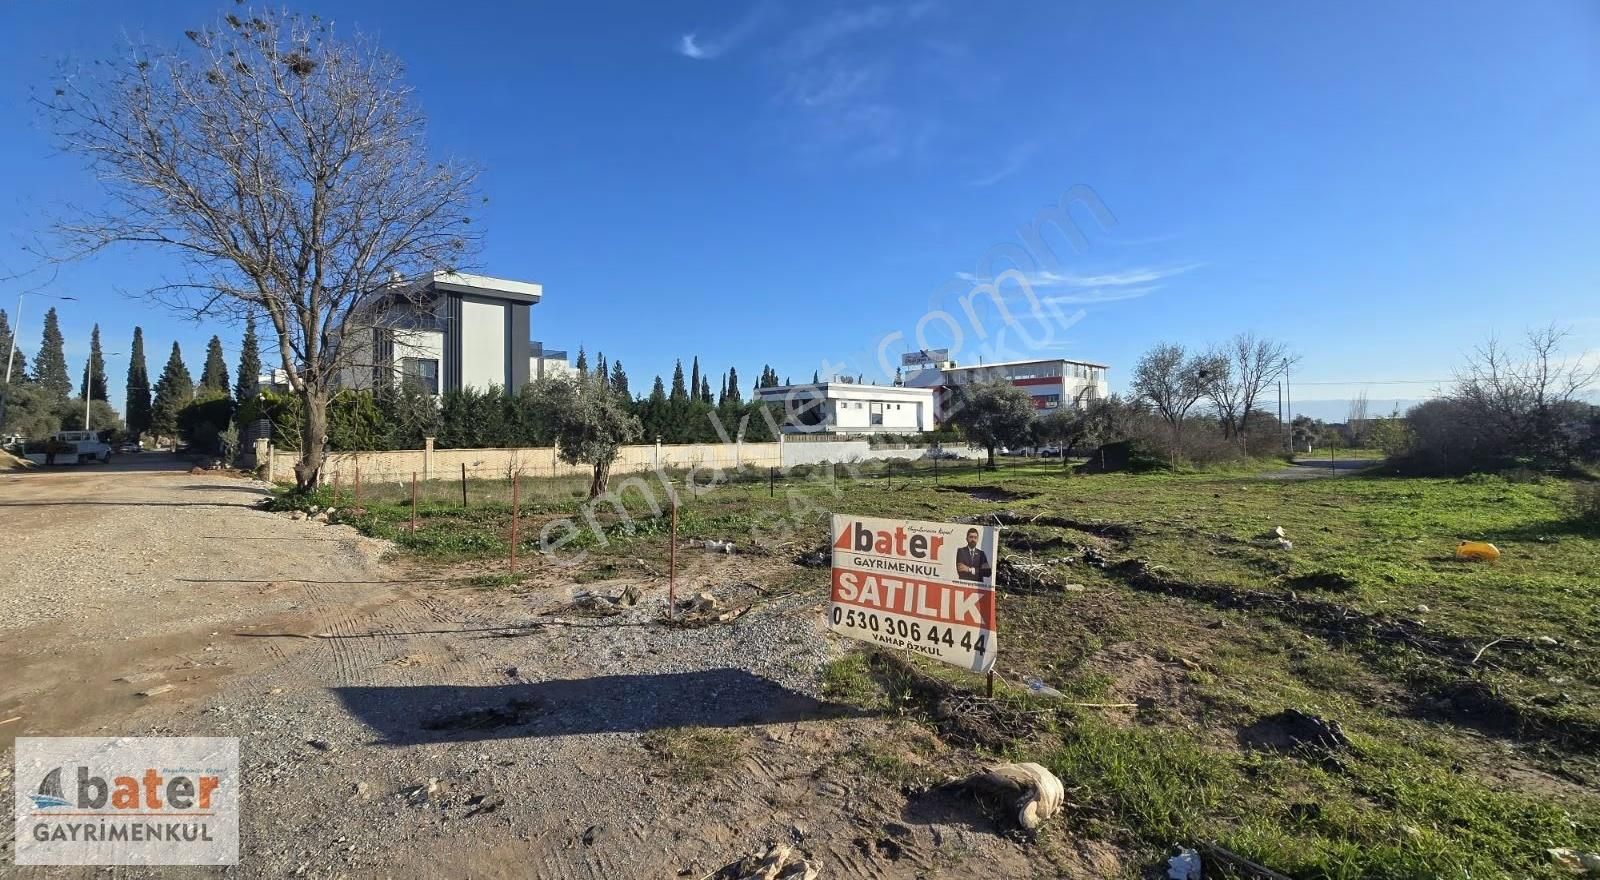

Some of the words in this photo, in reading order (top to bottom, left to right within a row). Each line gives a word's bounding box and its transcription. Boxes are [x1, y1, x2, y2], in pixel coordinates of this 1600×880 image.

[854, 522, 944, 561] bater
[854, 557, 940, 577] GAYRİMENKUL
[838, 572, 986, 625] SATILIK
[833, 606, 842, 625] 0
[845, 609, 880, 632] 530
[884, 617, 921, 642] 306
[927, 625, 954, 648] 44
[960, 630, 986, 656] 44
[872, 633, 905, 647] VAHAP
[906, 639, 944, 657] ÖZKUL
